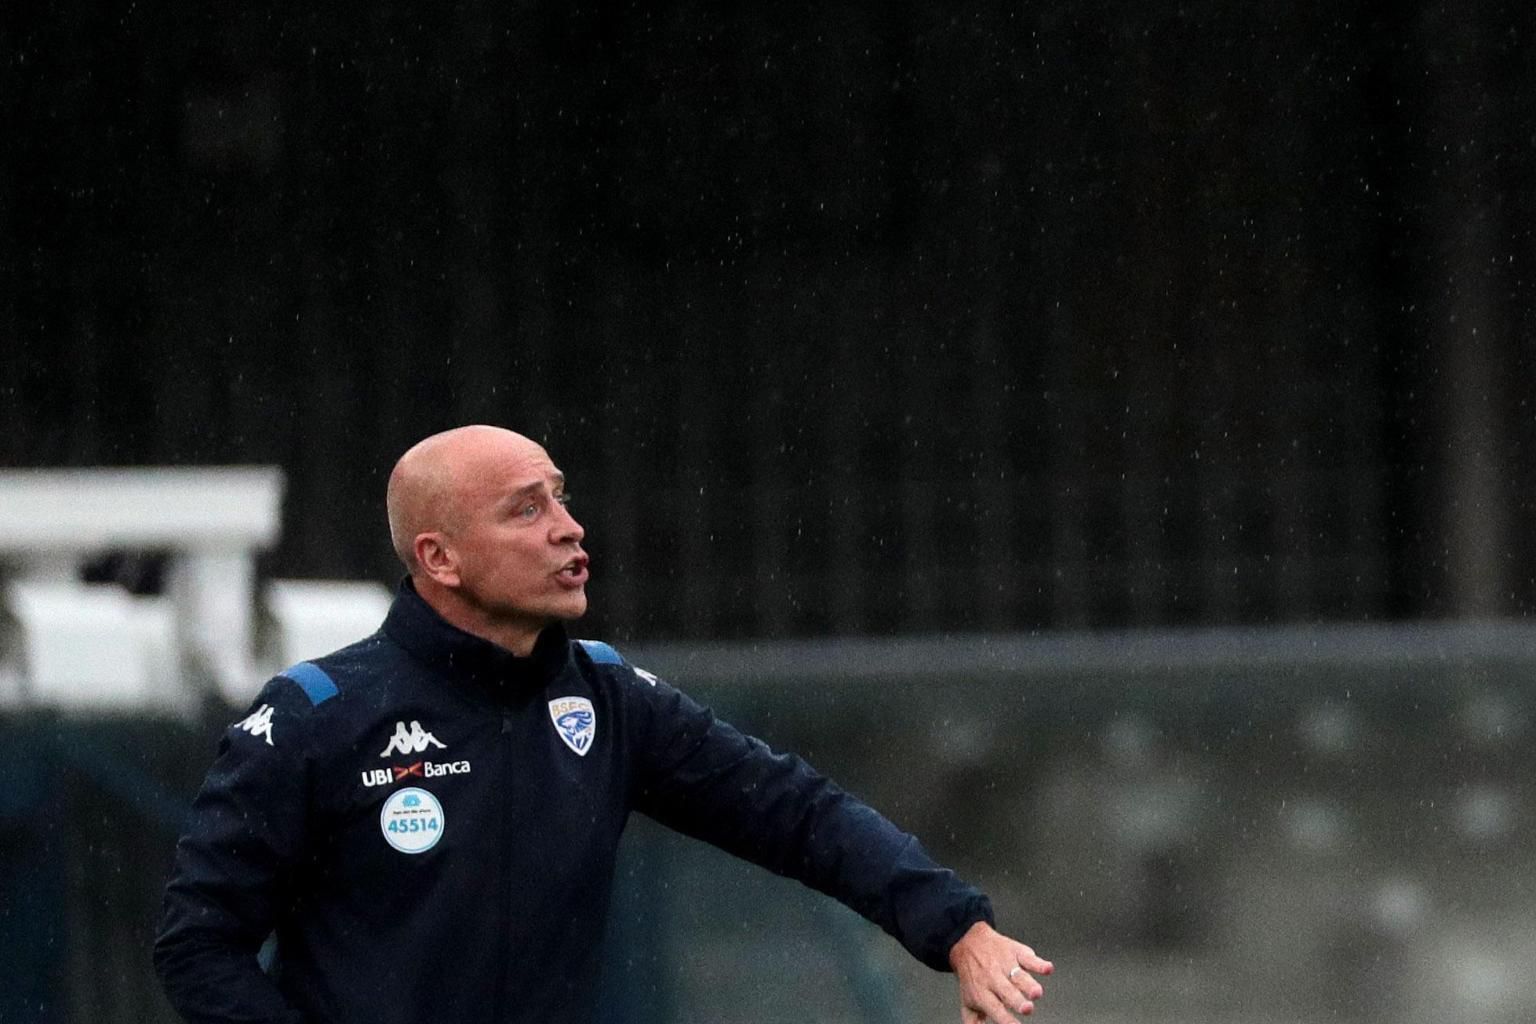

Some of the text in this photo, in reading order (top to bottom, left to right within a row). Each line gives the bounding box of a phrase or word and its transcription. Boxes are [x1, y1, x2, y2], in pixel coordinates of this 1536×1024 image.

[362, 760, 471, 787] UBI Banca
[388, 818, 438, 833] 45514
